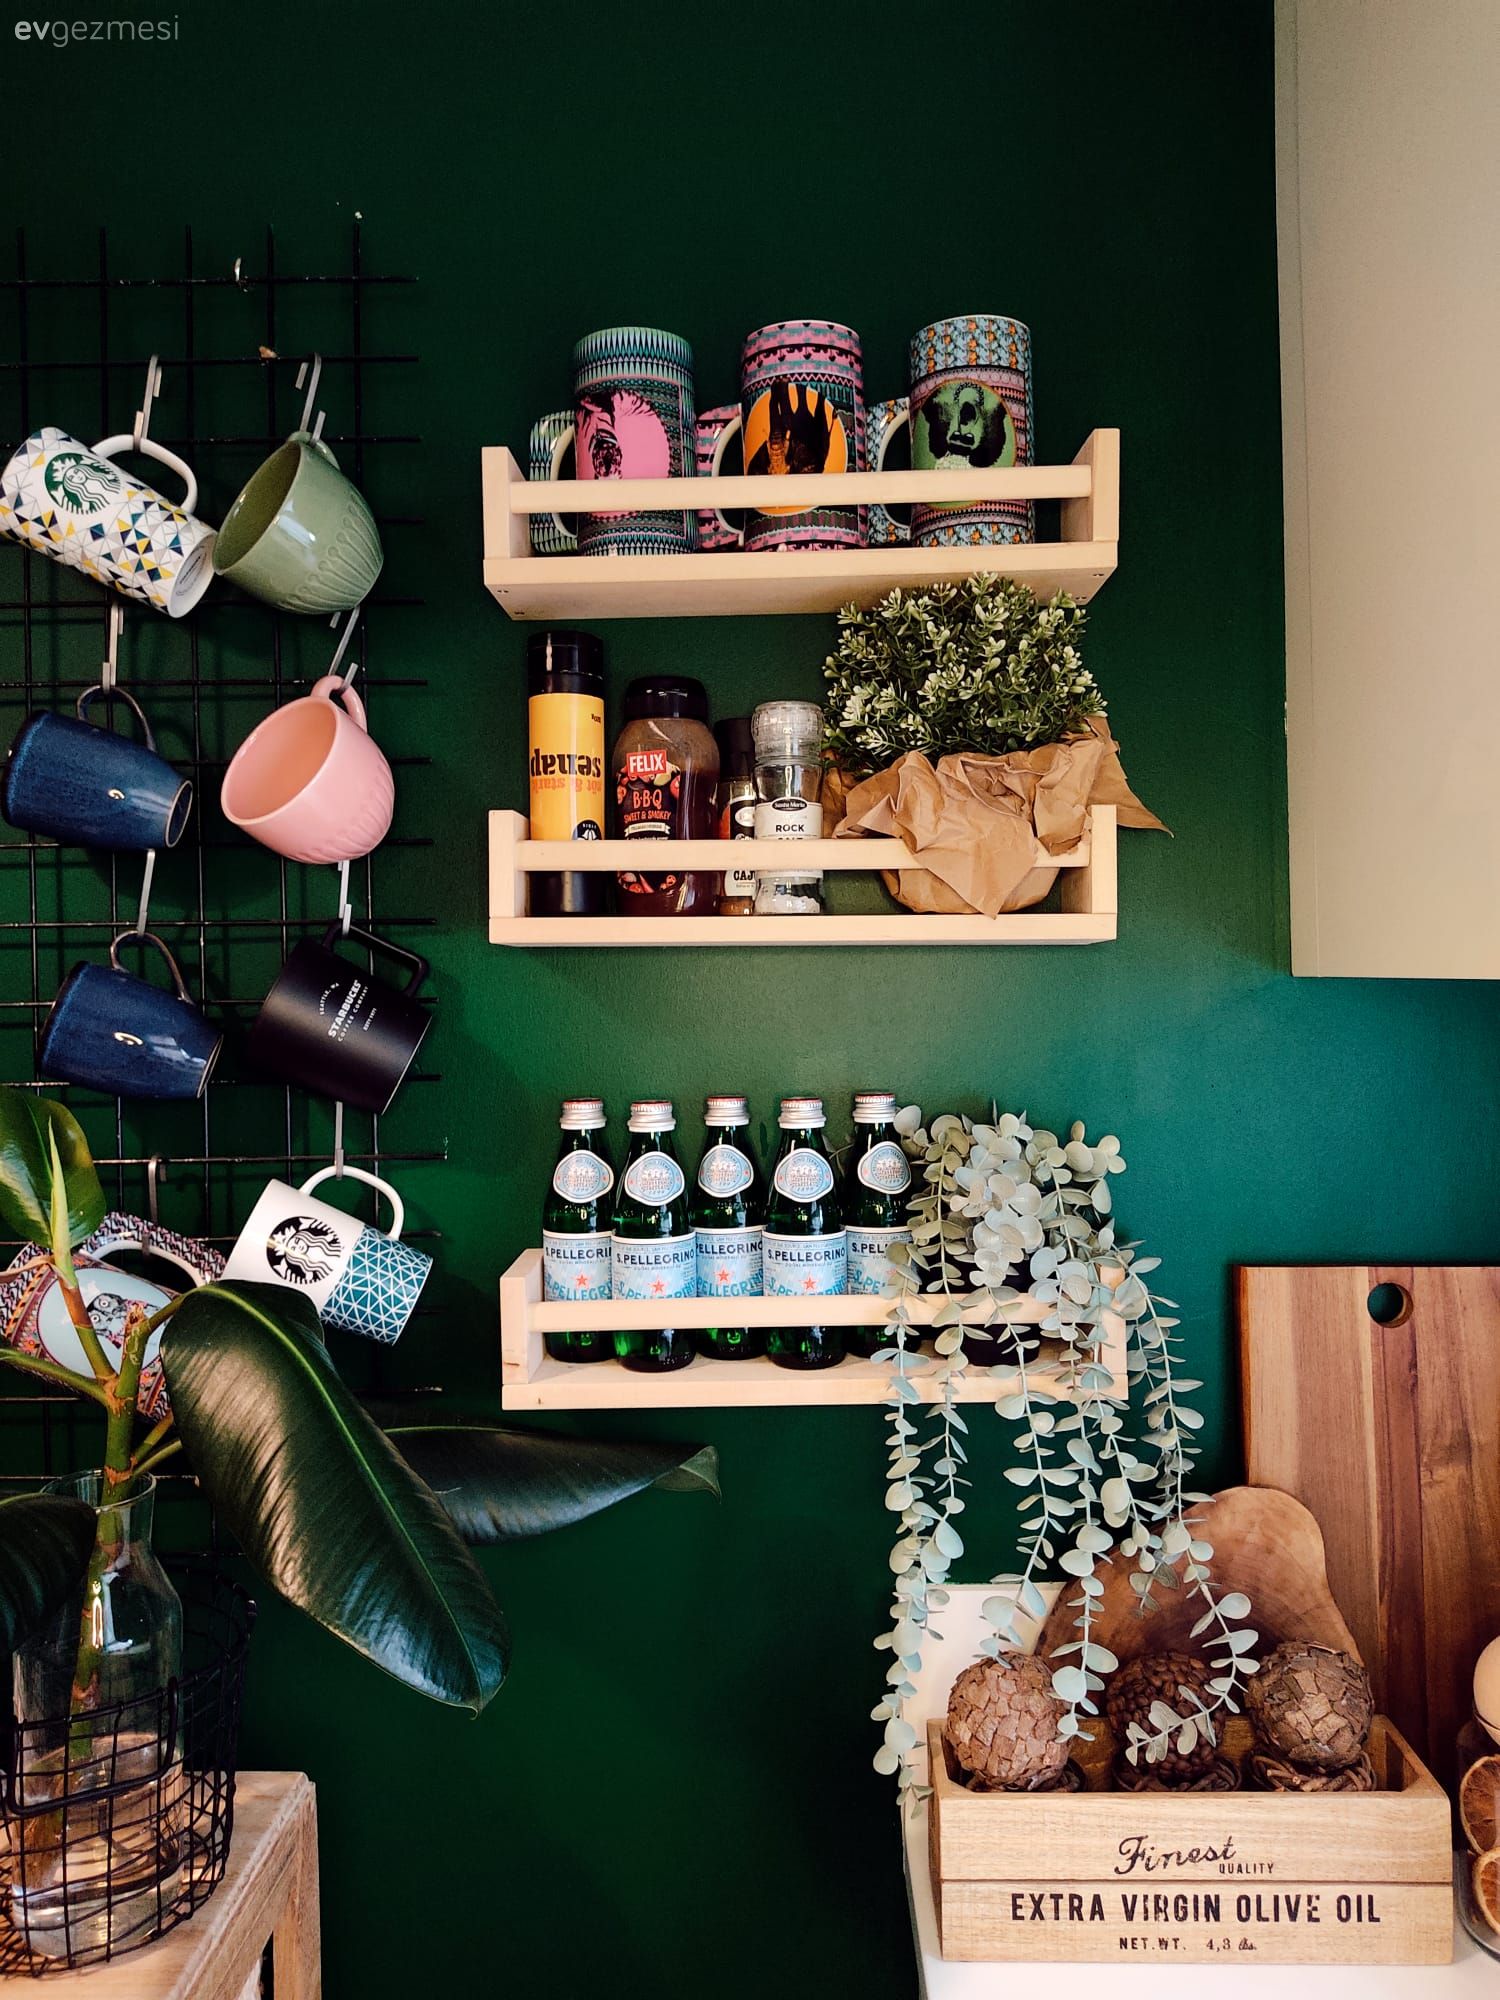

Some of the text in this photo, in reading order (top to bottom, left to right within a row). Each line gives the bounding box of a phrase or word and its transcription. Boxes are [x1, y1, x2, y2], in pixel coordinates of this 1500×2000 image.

[629, 753, 665, 773] FELIX
[623, 810, 672, 824] SWEET & SMOKEY
[775, 824, 805, 832] ROCK
[733, 870, 755, 881] CAJ
[328, 979, 362, 1038] STARBUCKS
[768, 1247, 846, 1262] S.PELLEGRINO
[851, 1242, 889, 1254] S.PEL
[616, 1249, 695, 1265] S.PELLEGRINO
[1114, 1834, 1237, 1875] Finest
[1219, 1863, 1275, 1875] QUALITY
[1011, 1893, 1381, 1923] EXTRA VIRGIN OLIVE OIL
